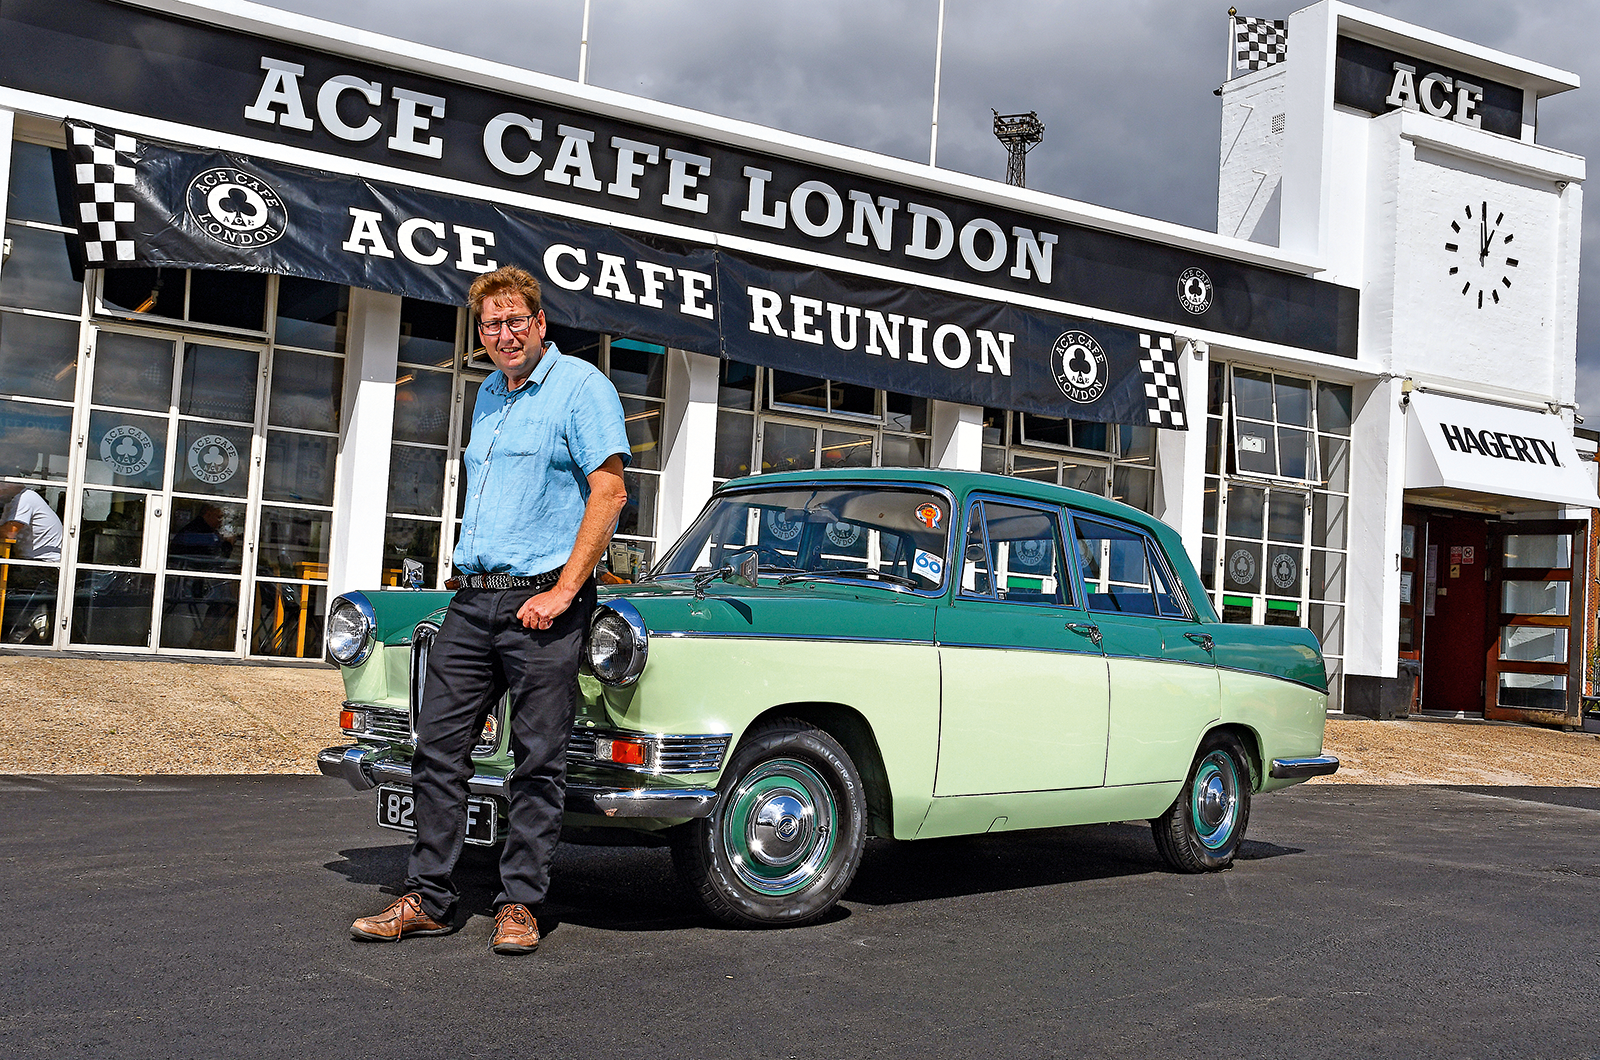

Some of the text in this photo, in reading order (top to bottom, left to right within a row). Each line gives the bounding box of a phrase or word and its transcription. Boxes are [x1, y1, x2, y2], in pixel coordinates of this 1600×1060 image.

[1386, 61, 1483, 129] ACE
[244, 56, 1058, 284] ACE CAFE LONDON
[195, 171, 280, 208] ACE CAFE
[197, 212, 278, 244] LONDON
[223, 216, 255, 227] ACE
[1181, 270, 1211, 290] ACE CAFE
[342, 206, 1015, 377] ACE CAFE REUNION
[1181, 294, 1209, 313] LONDON
[1055, 334, 1105, 364] ACE CAFE
[1057, 373, 1103, 400] LONDON
[104, 428, 125, 445] ACE
[128, 428, 151, 449] CAFE
[192, 437, 237, 457] ACE CAFE
[1440, 423, 1560, 467] HAGERTY
[103, 455, 148, 474] LONDON
[191, 464, 233, 482] LONDON
[769, 523, 800, 539] LONDON
[829, 530, 857, 546] LONDON
[915, 552, 941, 574] 60
[387, 793, 418, 827] 82
